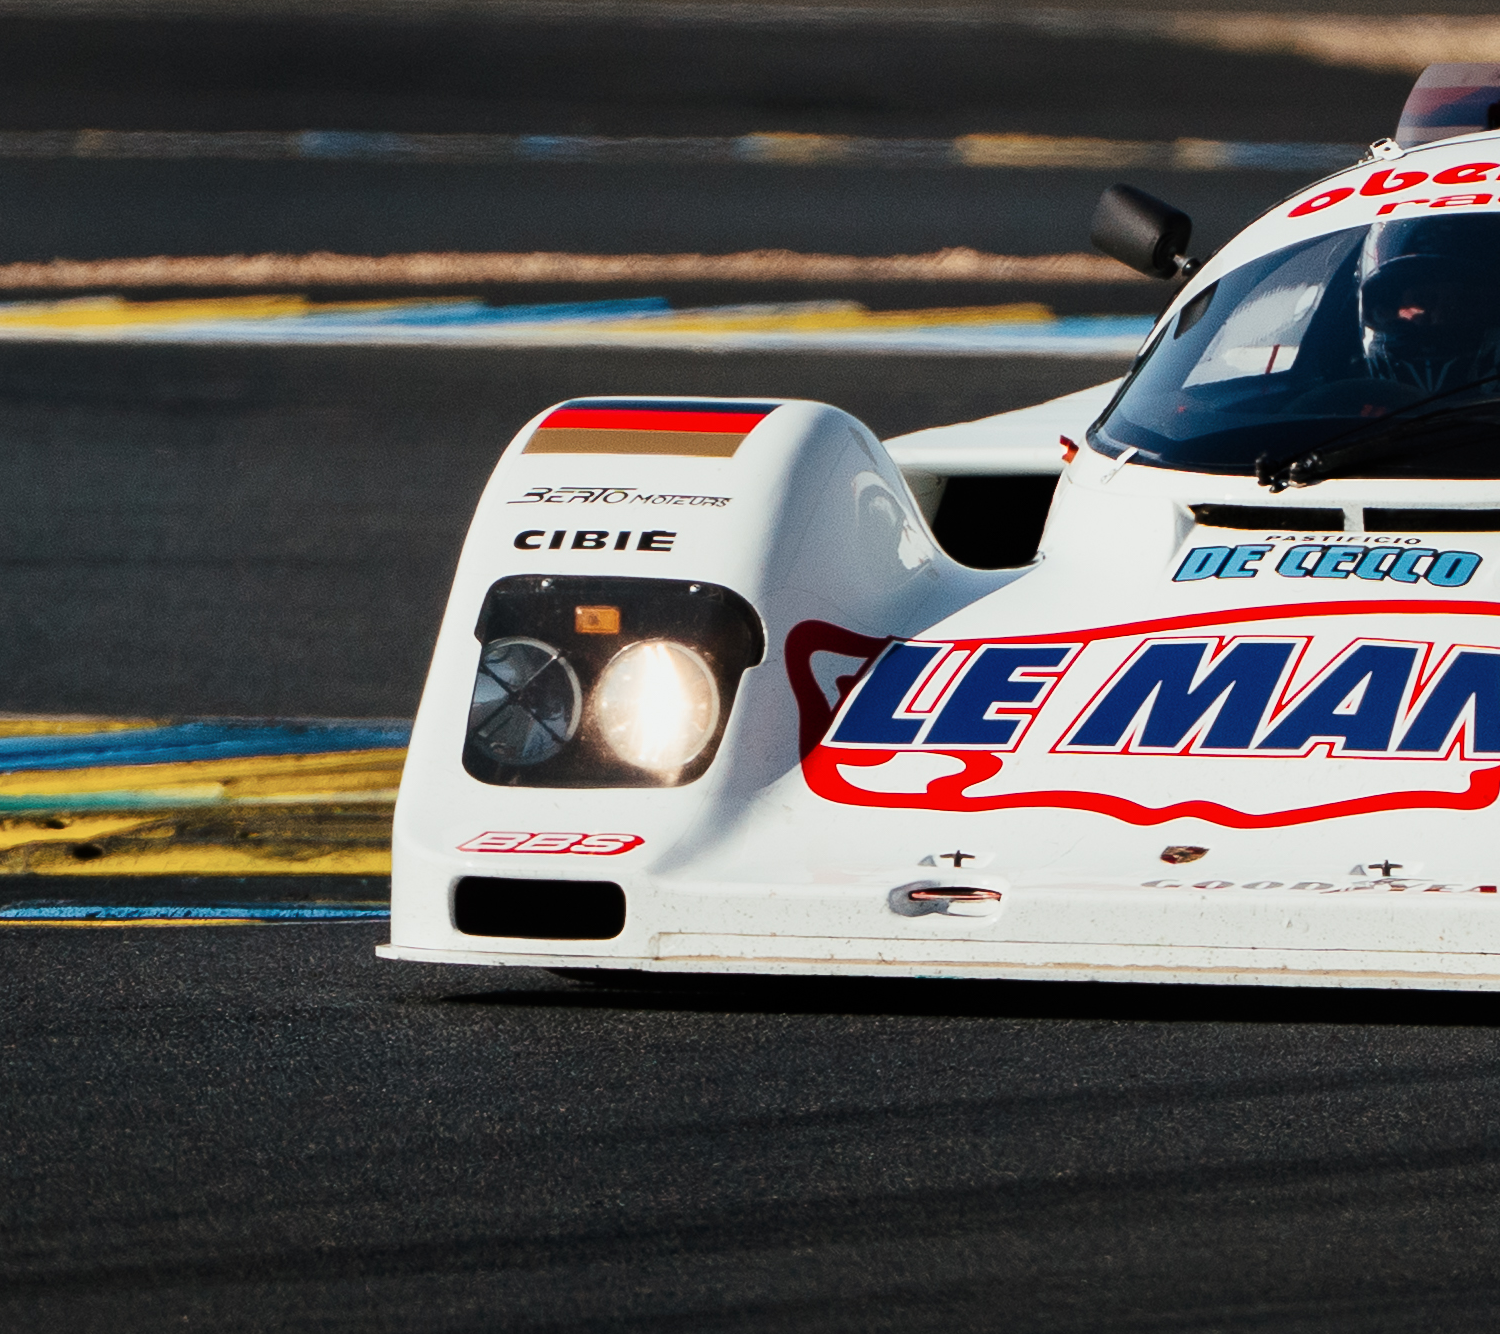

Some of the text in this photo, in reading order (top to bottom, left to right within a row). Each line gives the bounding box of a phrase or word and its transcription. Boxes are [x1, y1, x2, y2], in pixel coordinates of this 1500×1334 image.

[506, 487, 637, 504] BERTO
[1265, 535, 1422, 545] PASTIFICIO
[1171, 544, 1484, 588] DE CECCO
[820, 640, 1080, 754] LE
[455, 831, 645, 855] BBS
